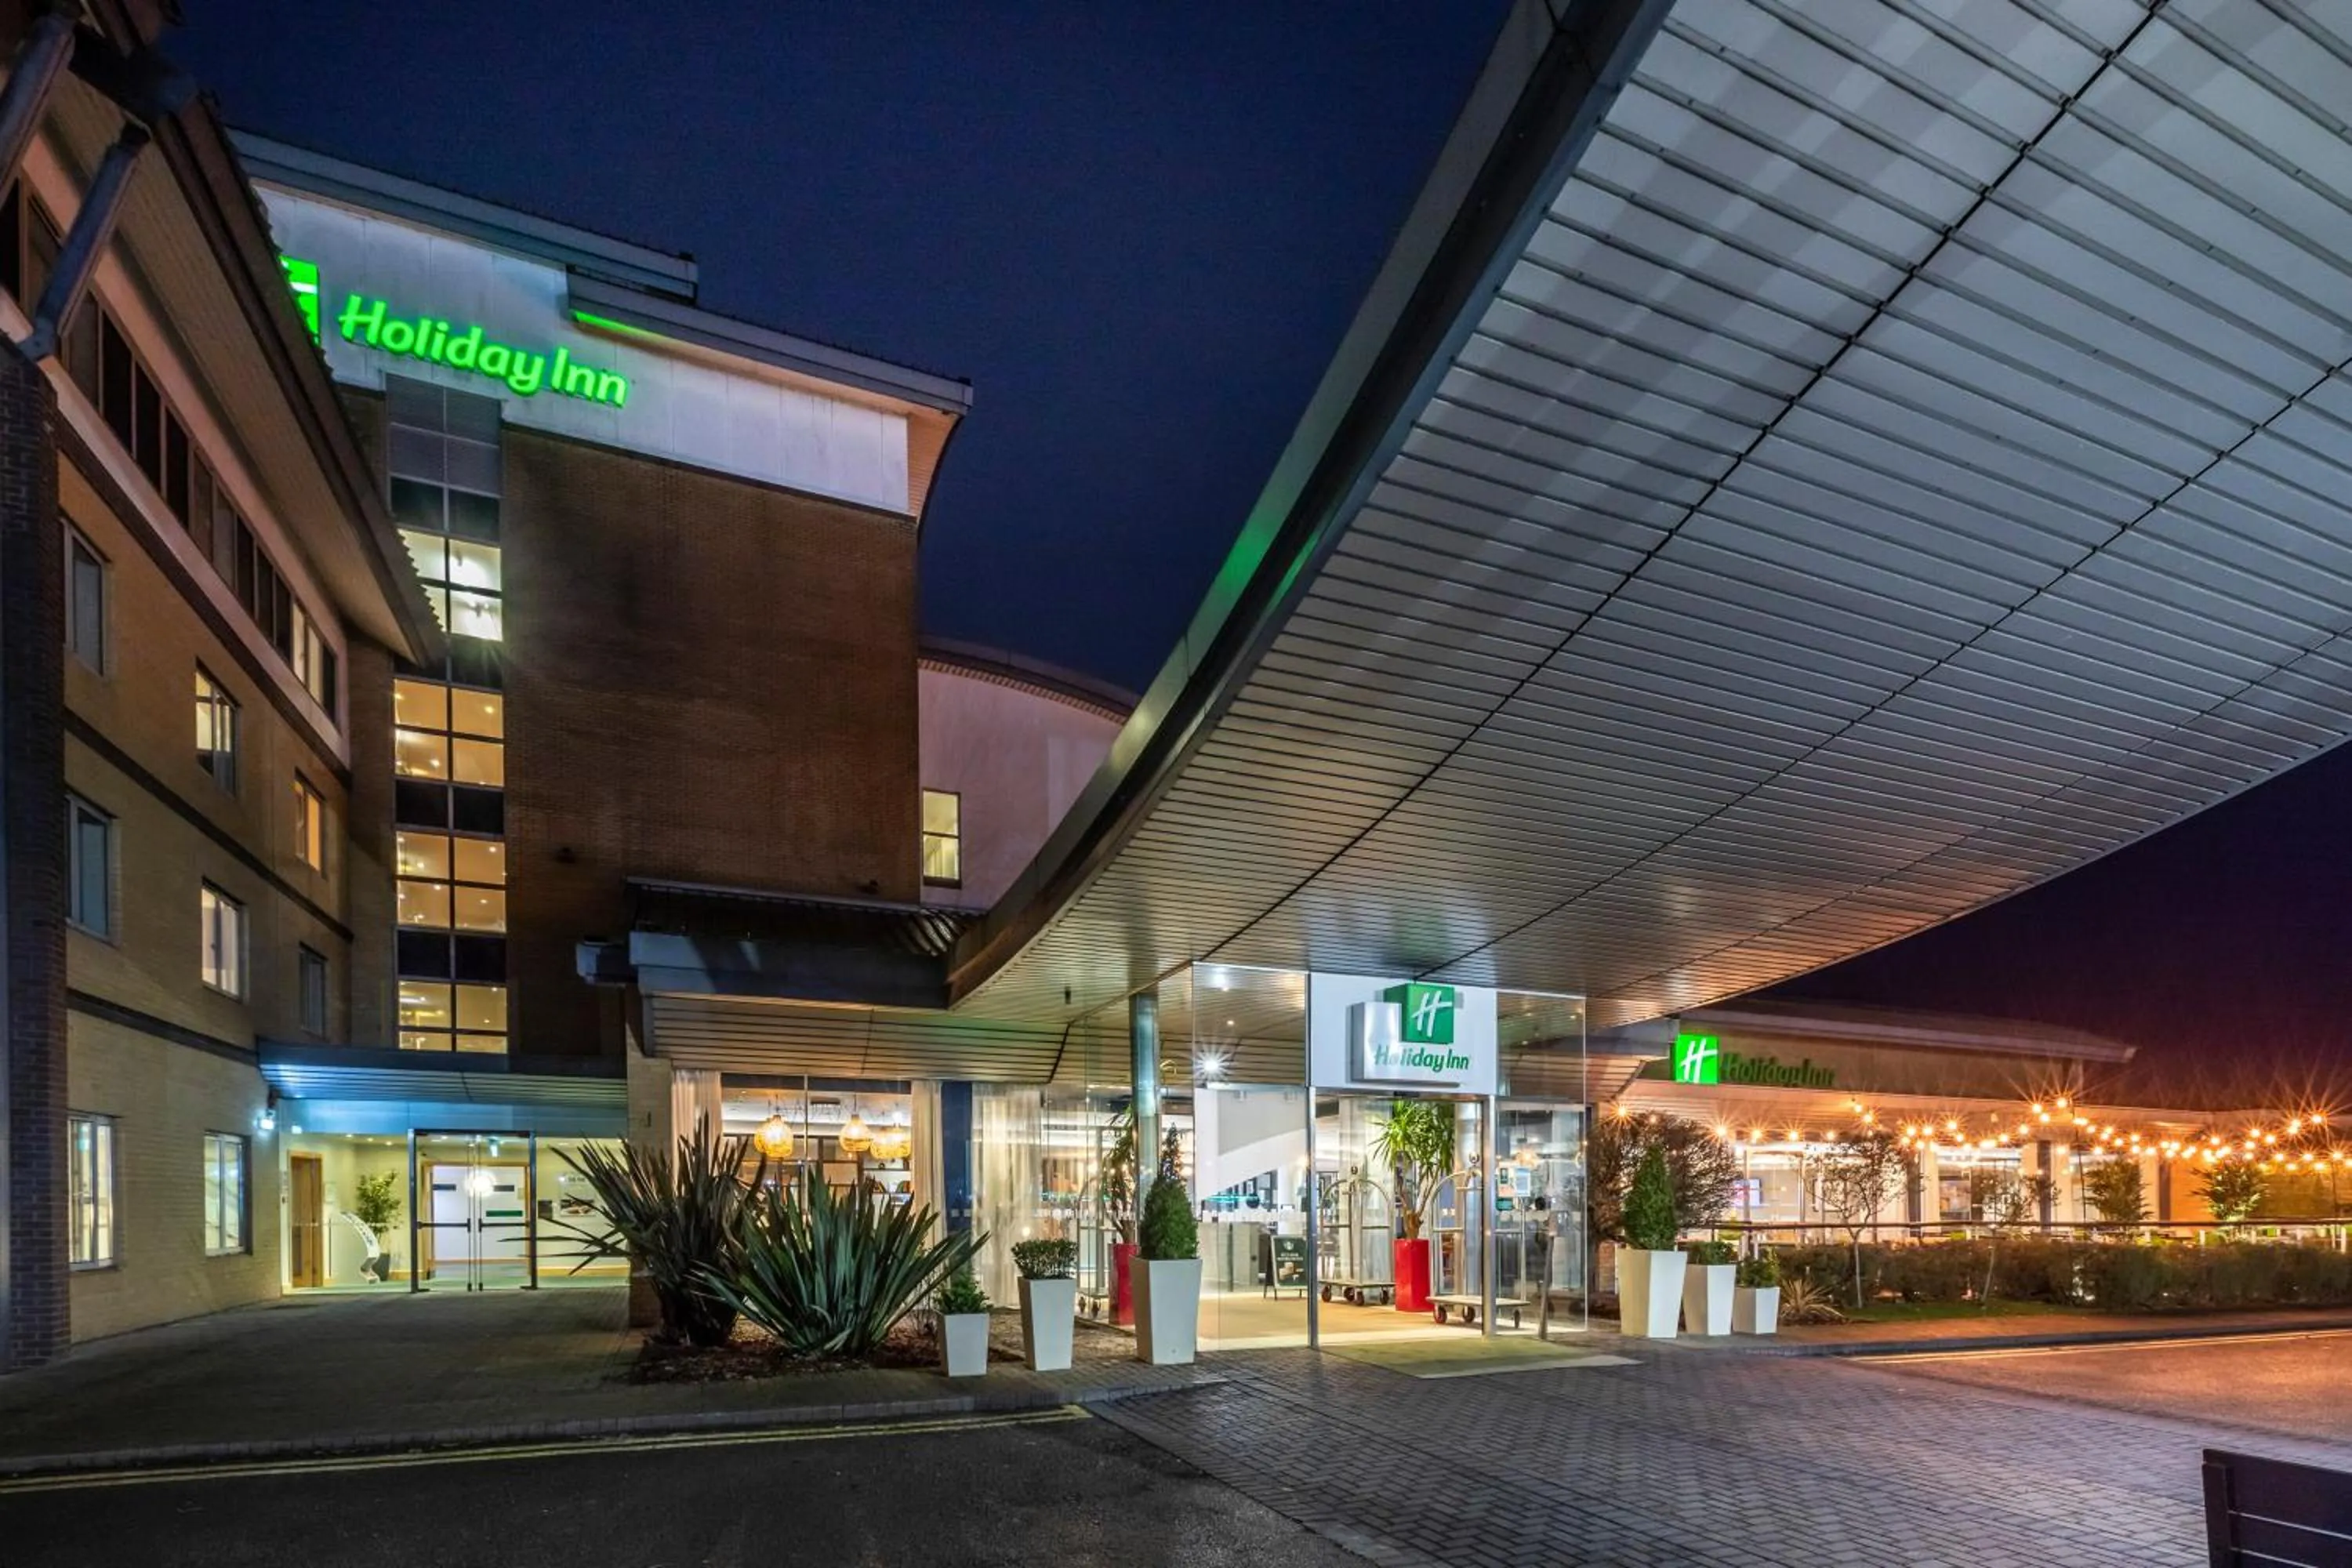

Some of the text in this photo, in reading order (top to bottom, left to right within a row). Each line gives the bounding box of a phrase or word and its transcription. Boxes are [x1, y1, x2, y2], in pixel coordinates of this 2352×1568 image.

[339, 294, 627, 408] Holiday Inn
[1374, 1044, 1470, 1073] Holiday Inn
[1720, 1053, 1835, 1087] Holiday Inn
